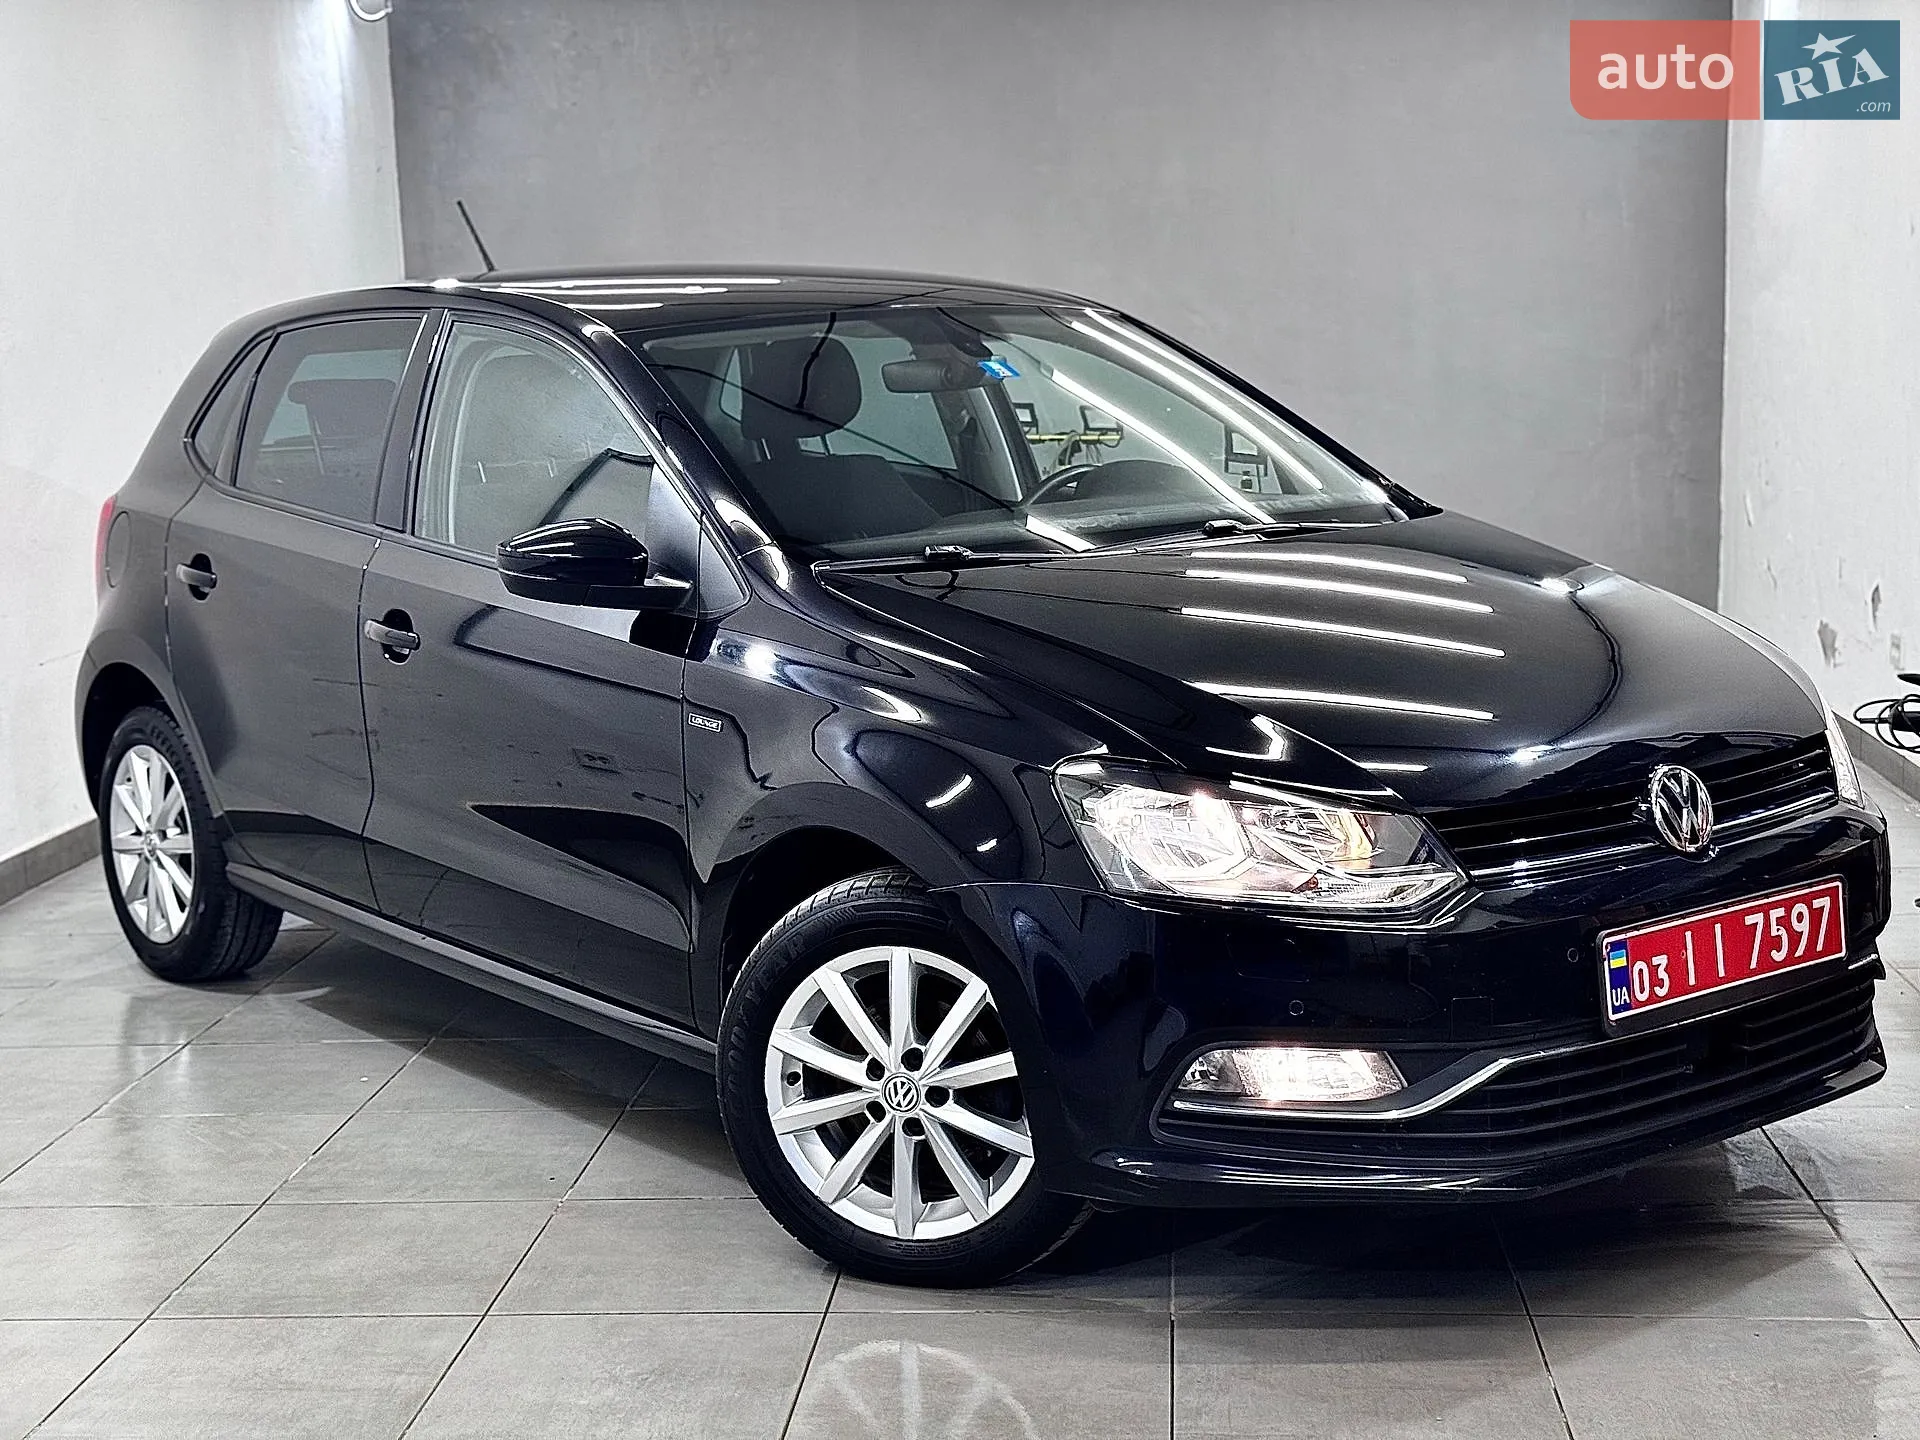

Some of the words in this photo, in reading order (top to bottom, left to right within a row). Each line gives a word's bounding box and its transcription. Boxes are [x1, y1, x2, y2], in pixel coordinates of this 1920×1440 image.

[692, 716, 719, 729] LOUNGE
[1632, 954, 1670, 1002] 03
[1744, 896, 1831, 970] 7597
[1612, 986, 1630, 1007] UA
